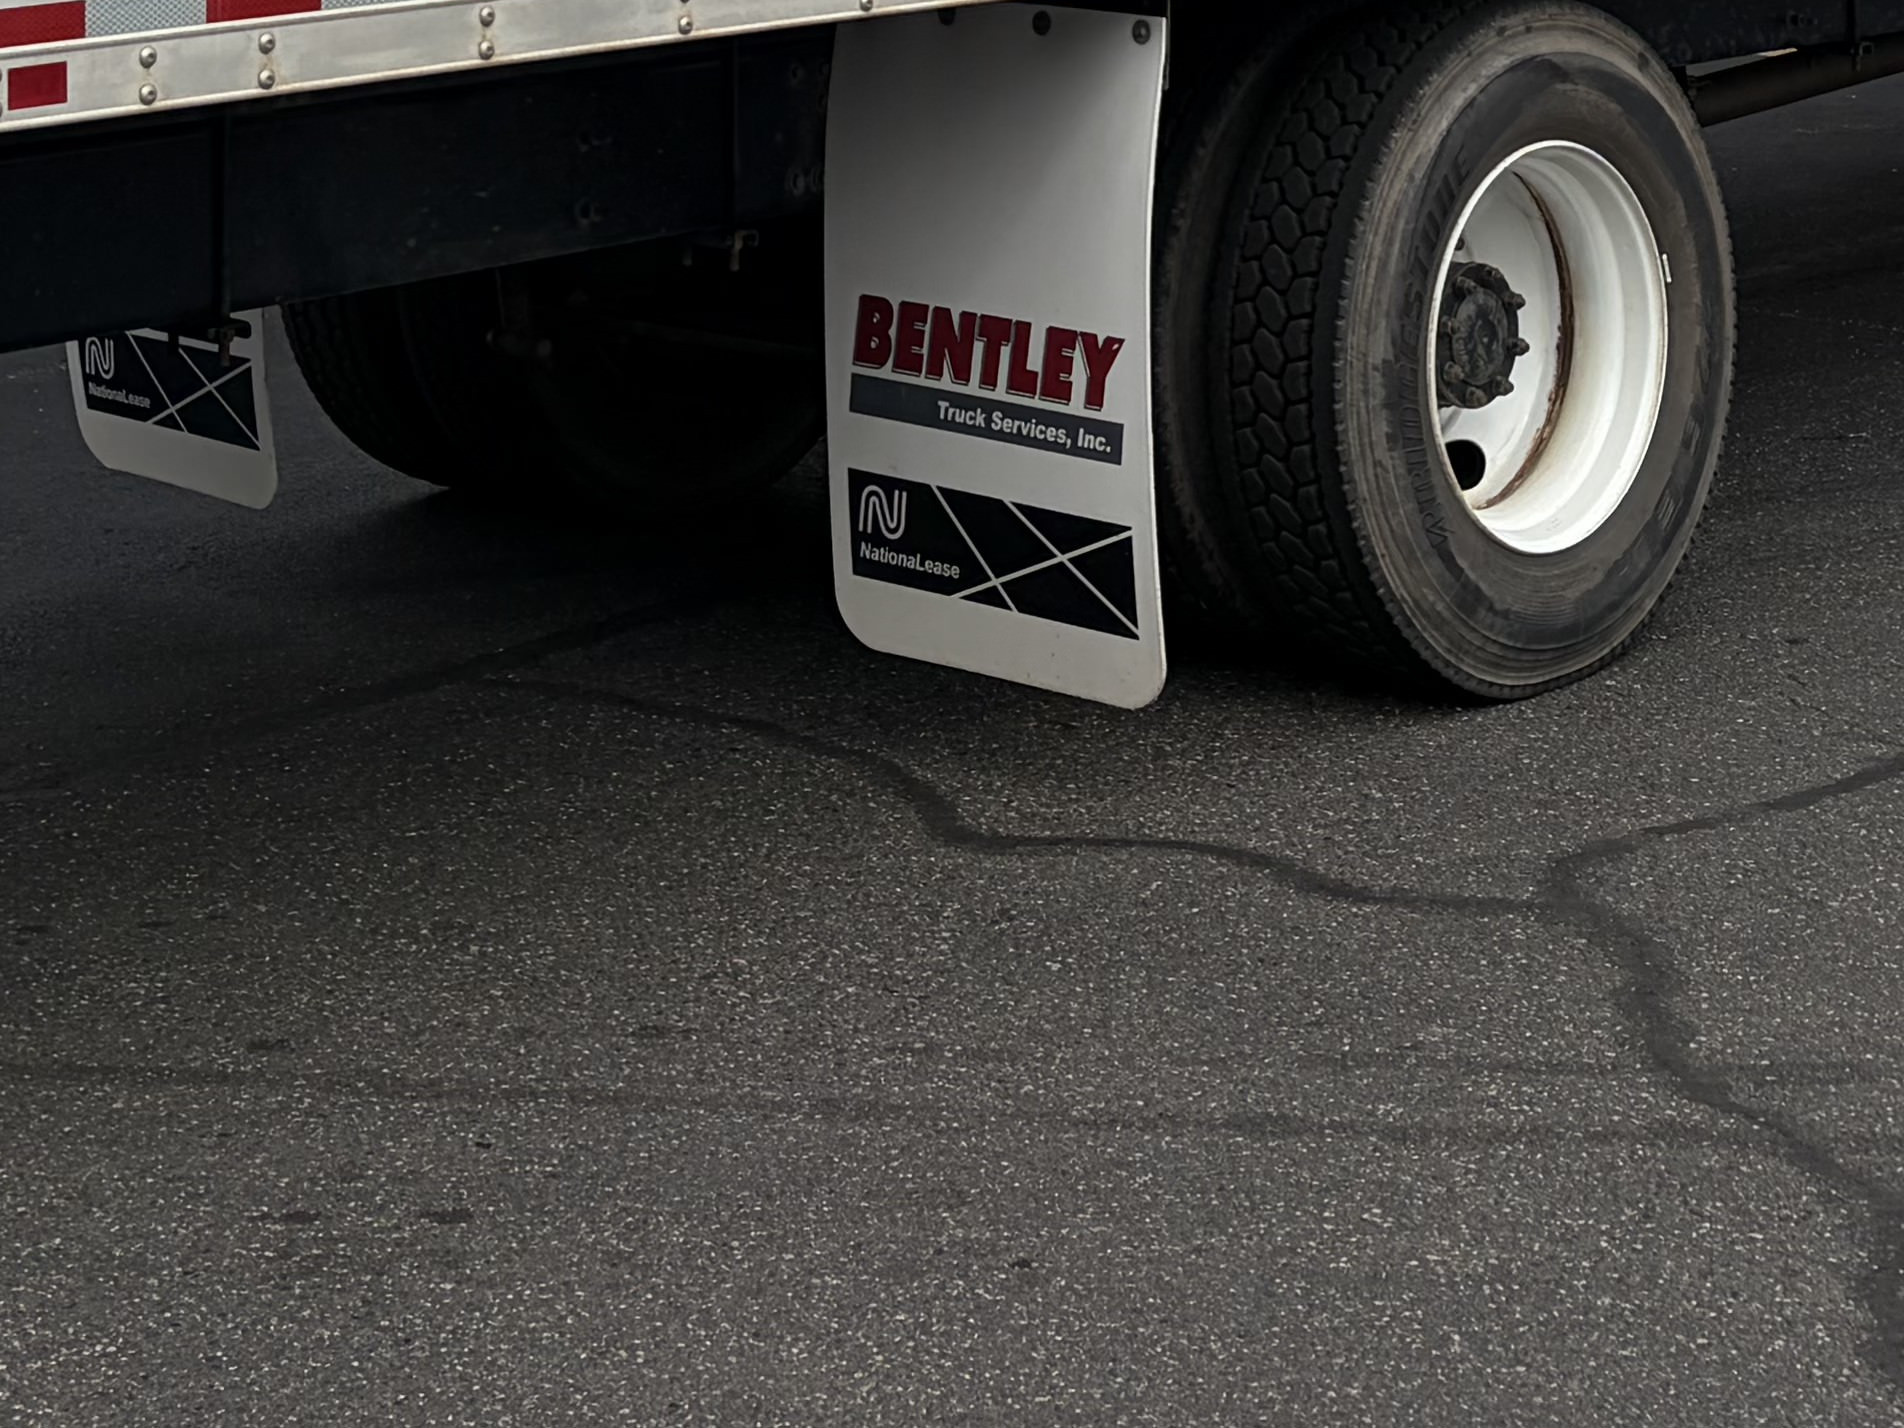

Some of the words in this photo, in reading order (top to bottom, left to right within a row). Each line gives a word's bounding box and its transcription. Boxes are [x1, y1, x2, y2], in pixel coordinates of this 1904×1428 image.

[852, 293, 1126, 412] BENTLEY
[88, 381, 151, 409] NationaLease
[937, 399, 986, 429] Truck
[990, 410, 1072, 450] Services,
[1076, 427, 1112, 454] Inc.
[860, 540, 961, 580] NationaLease
